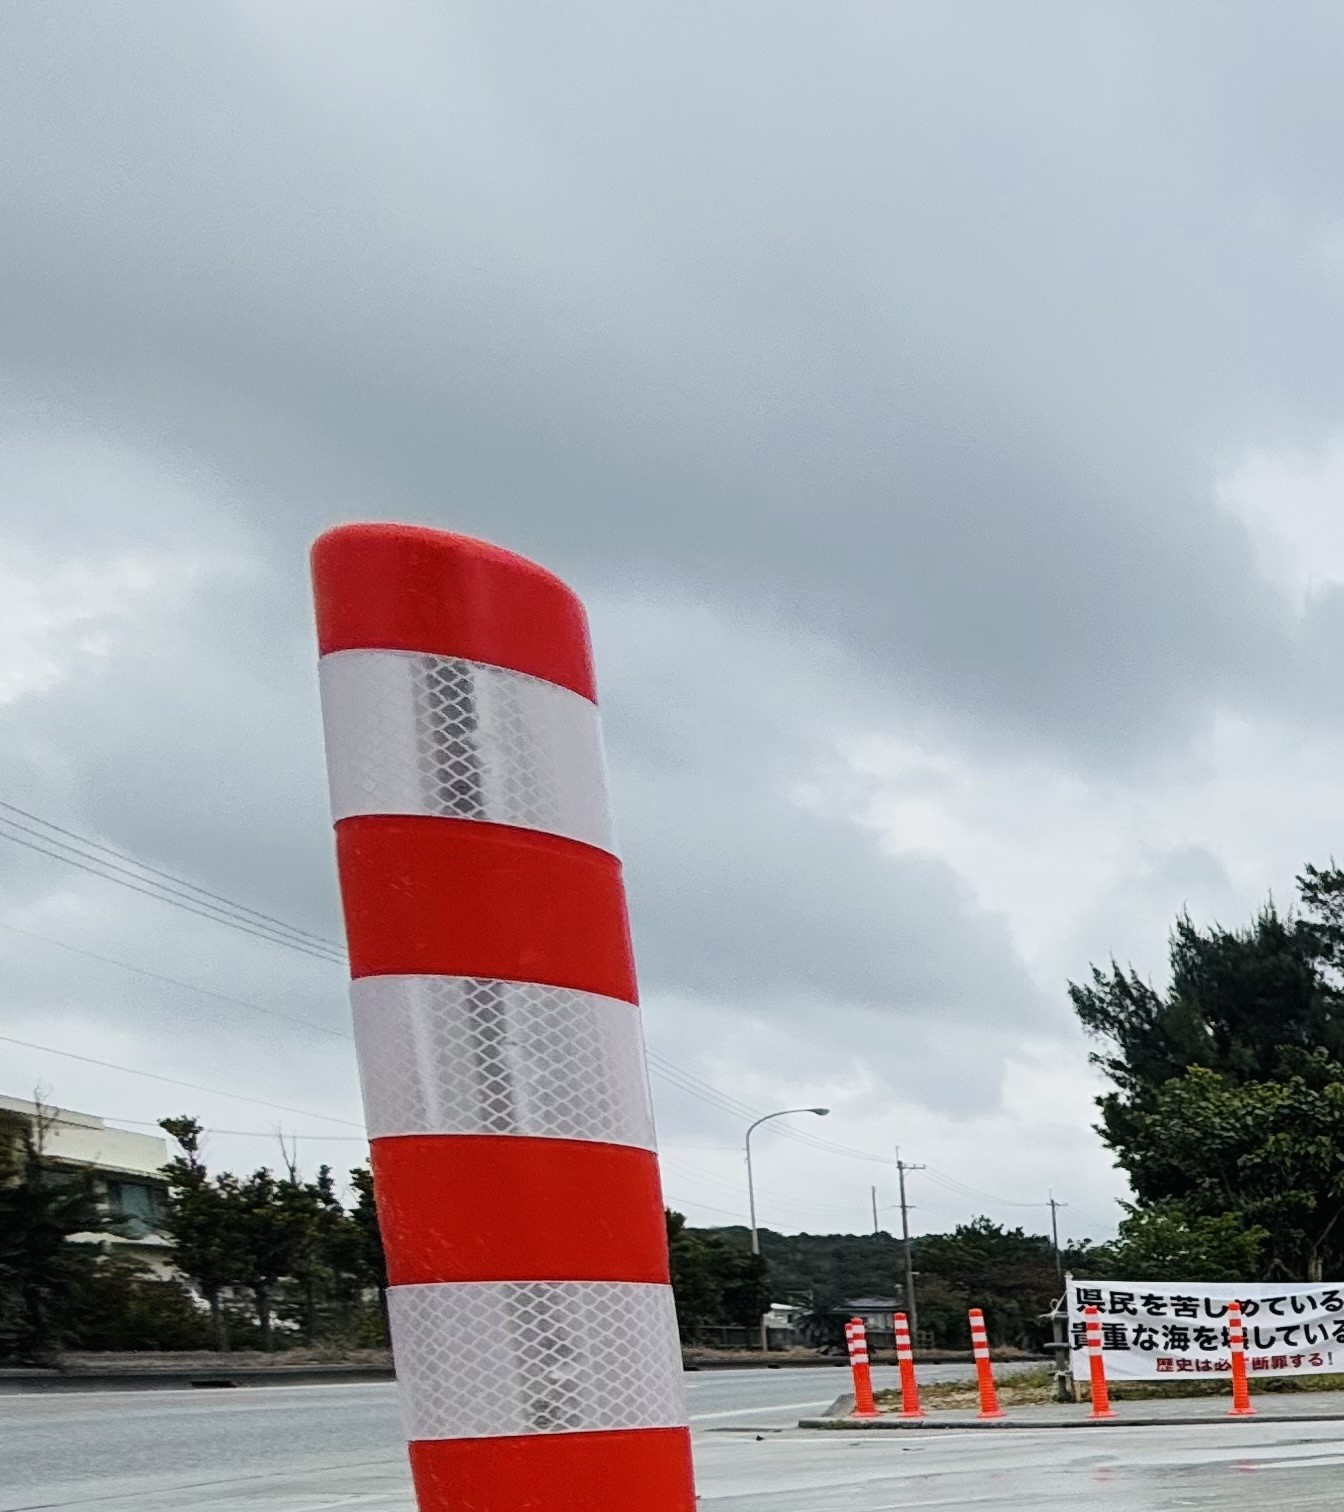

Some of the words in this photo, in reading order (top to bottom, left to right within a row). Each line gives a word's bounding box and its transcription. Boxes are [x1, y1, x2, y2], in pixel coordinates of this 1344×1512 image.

[1156, 1352, 1334, 1372] 歴史は必断罪する!
